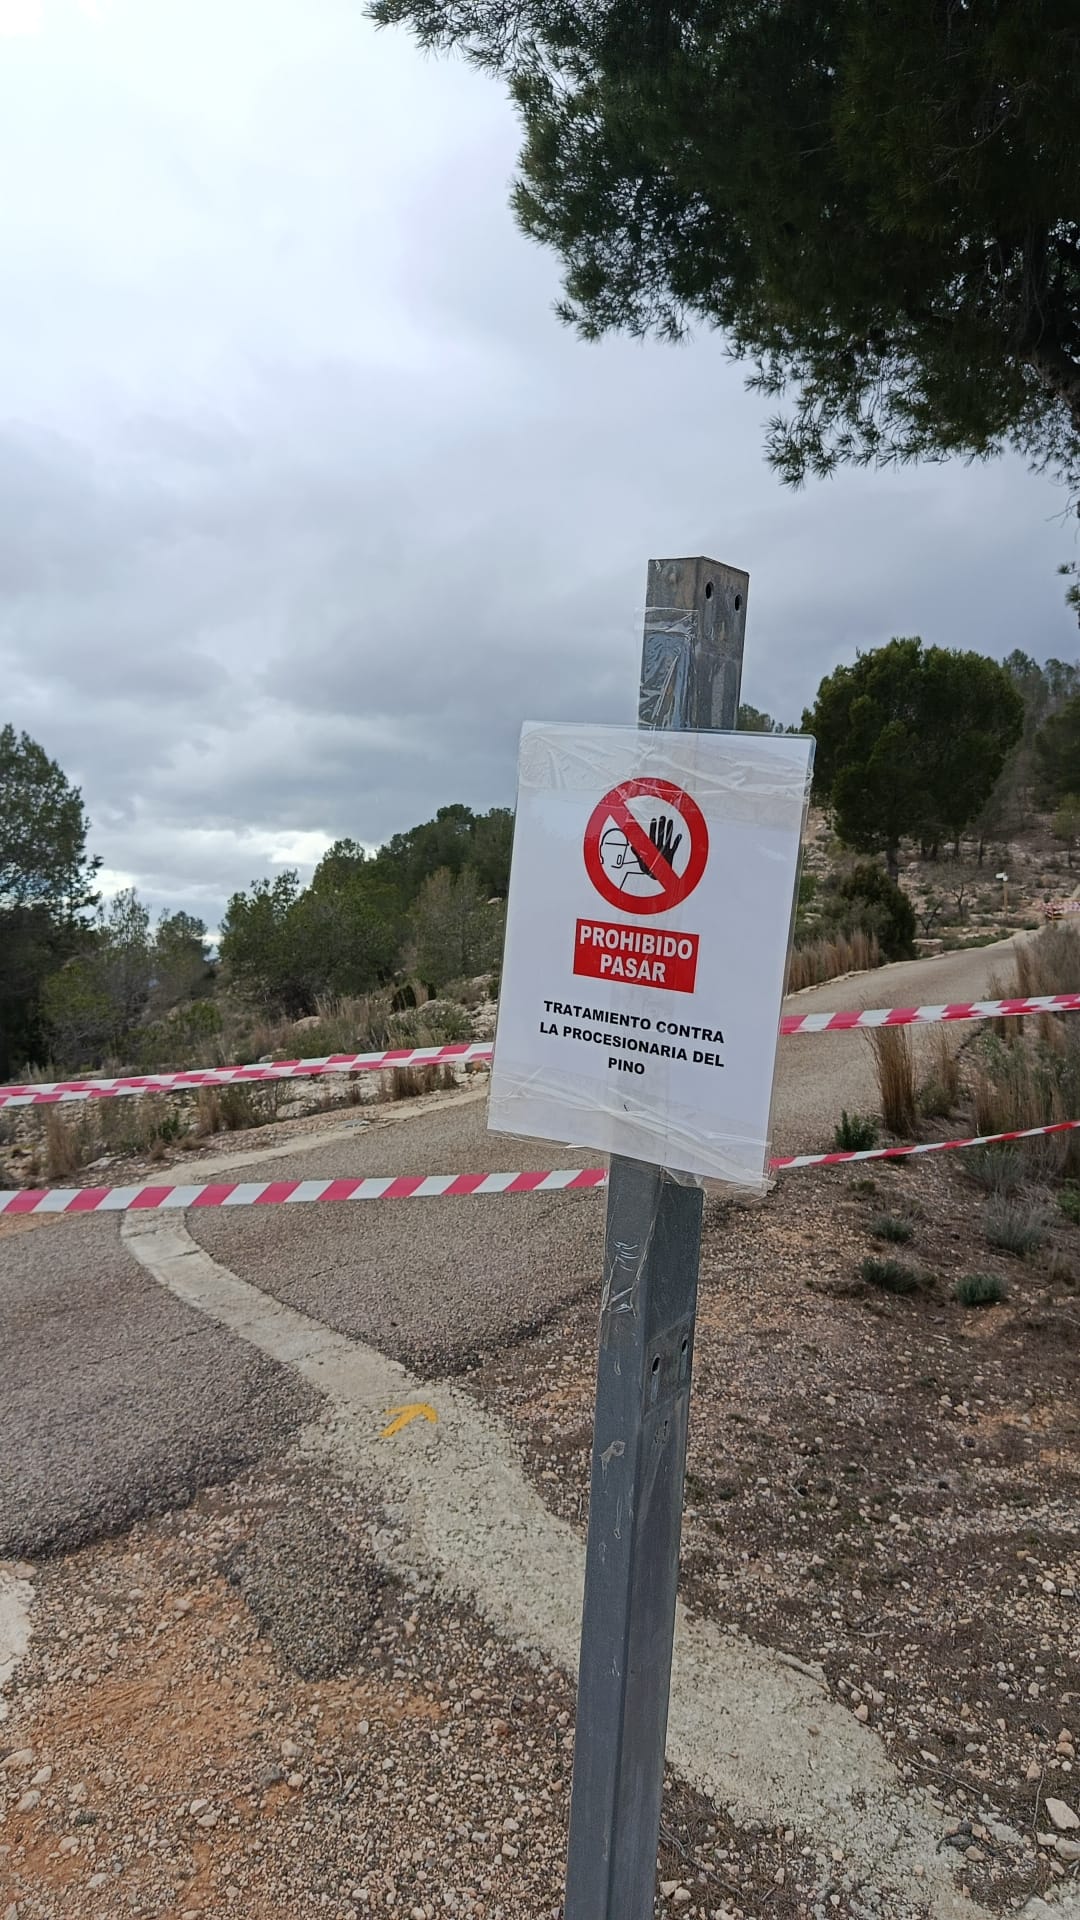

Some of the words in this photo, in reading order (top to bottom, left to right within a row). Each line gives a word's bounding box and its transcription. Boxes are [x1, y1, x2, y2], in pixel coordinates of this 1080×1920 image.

[580, 925, 693, 960] PROHIBIDO
[600, 953, 666, 983] PASAR
[543, 1000, 651, 1031] TRATAMIENTO
[656, 1020, 725, 1044] CONTRA
[539, 1021, 559, 1036] LA
[563, 1025, 688, 1061] PROCESIONARIA
[692, 1050, 725, 1068] DEL
[608, 1056, 646, 1075] PINO
